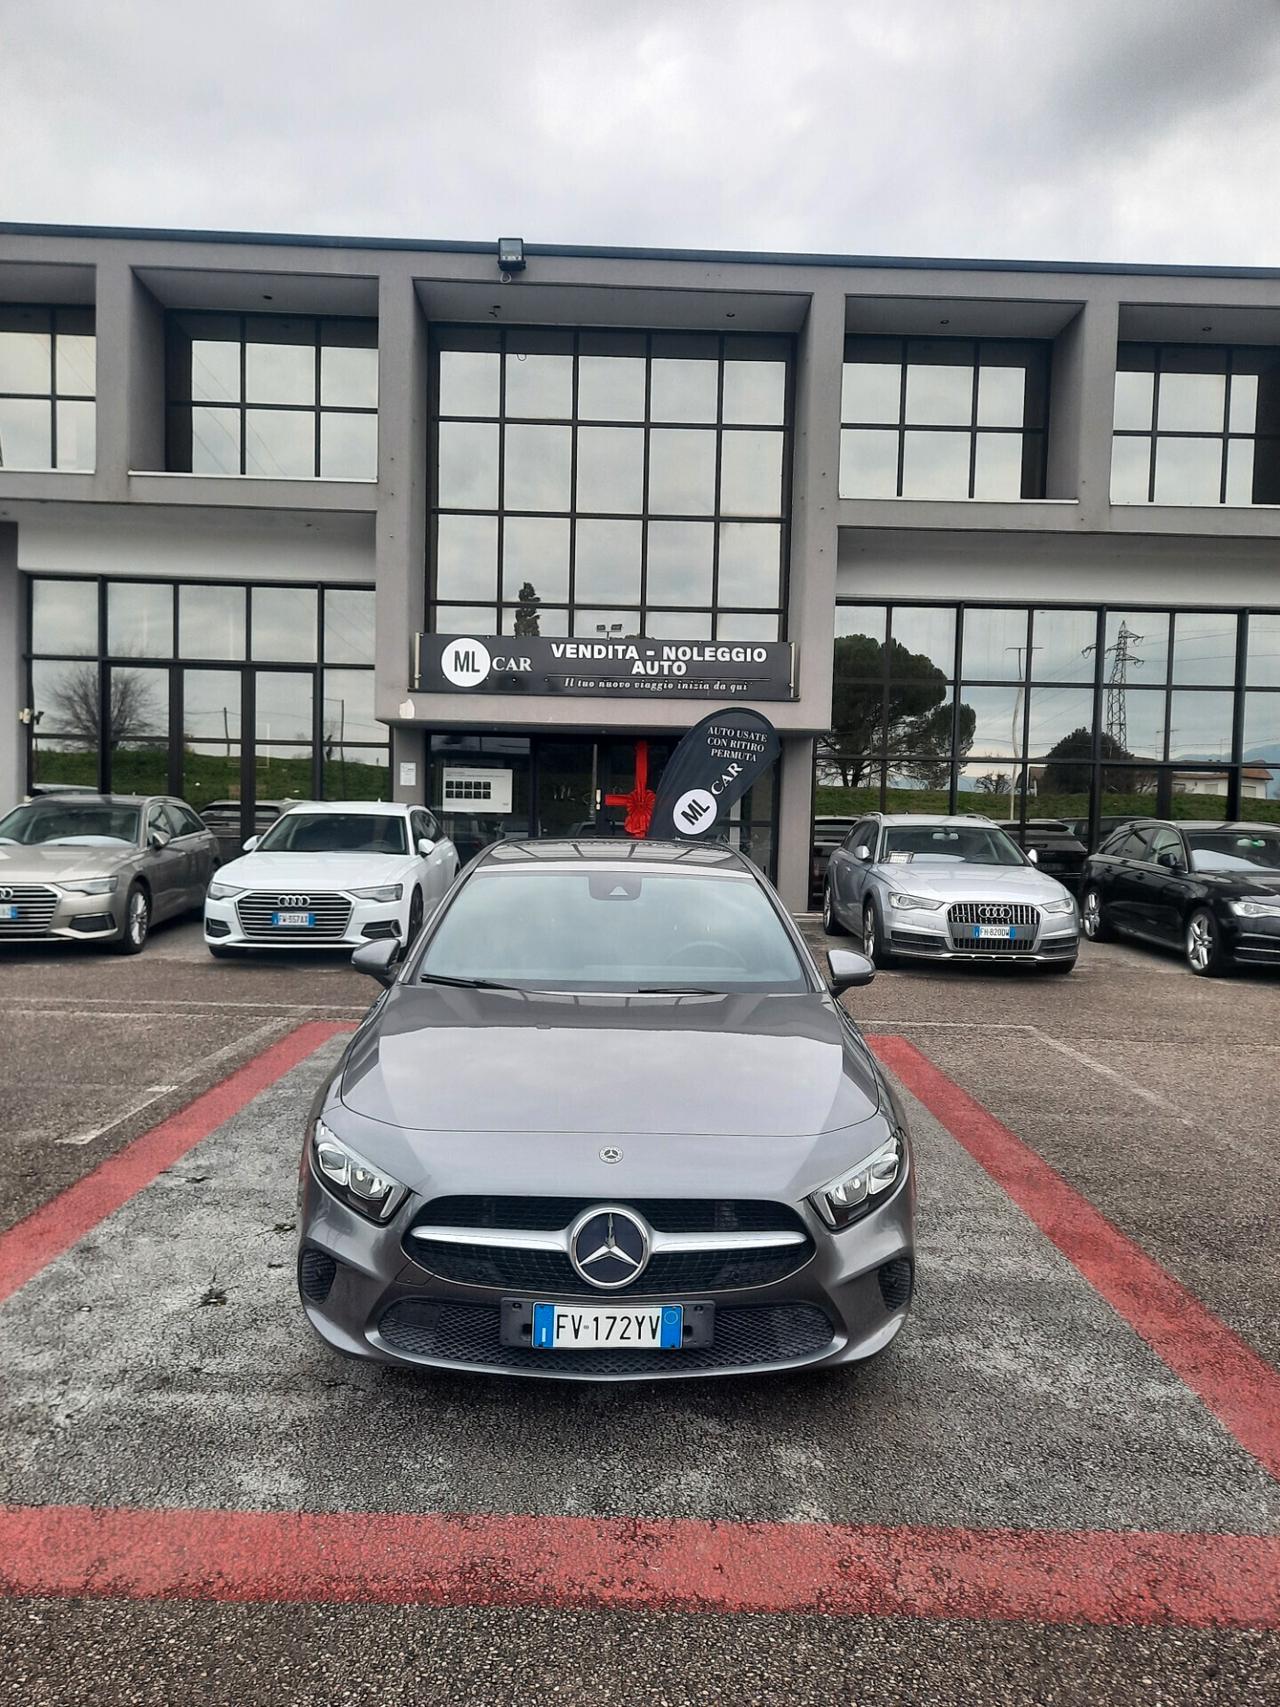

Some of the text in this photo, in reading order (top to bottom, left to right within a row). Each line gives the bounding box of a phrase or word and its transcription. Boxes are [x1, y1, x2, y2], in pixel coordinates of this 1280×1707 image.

[551, 643, 640, 660] VENDITA
[662, 646, 768, 663] NOLEGGIO
[454, 650, 532, 673] ML CAR
[631, 660, 688, 676] AUTO
[564, 678, 575, 687] Il
[577, 680, 595, 688] tuo
[598, 680, 631, 688] nuovo
[634, 680, 674, 691] viaggio
[677, 681, 710, 691] inizia
[713, 681, 727, 690] da
[707, 726, 768, 743] AUTO USATE
[707, 737, 765, 753] CON RITIRO
[710, 748, 757, 762] PERMUTA
[680, 762, 744, 826] ML CAR
